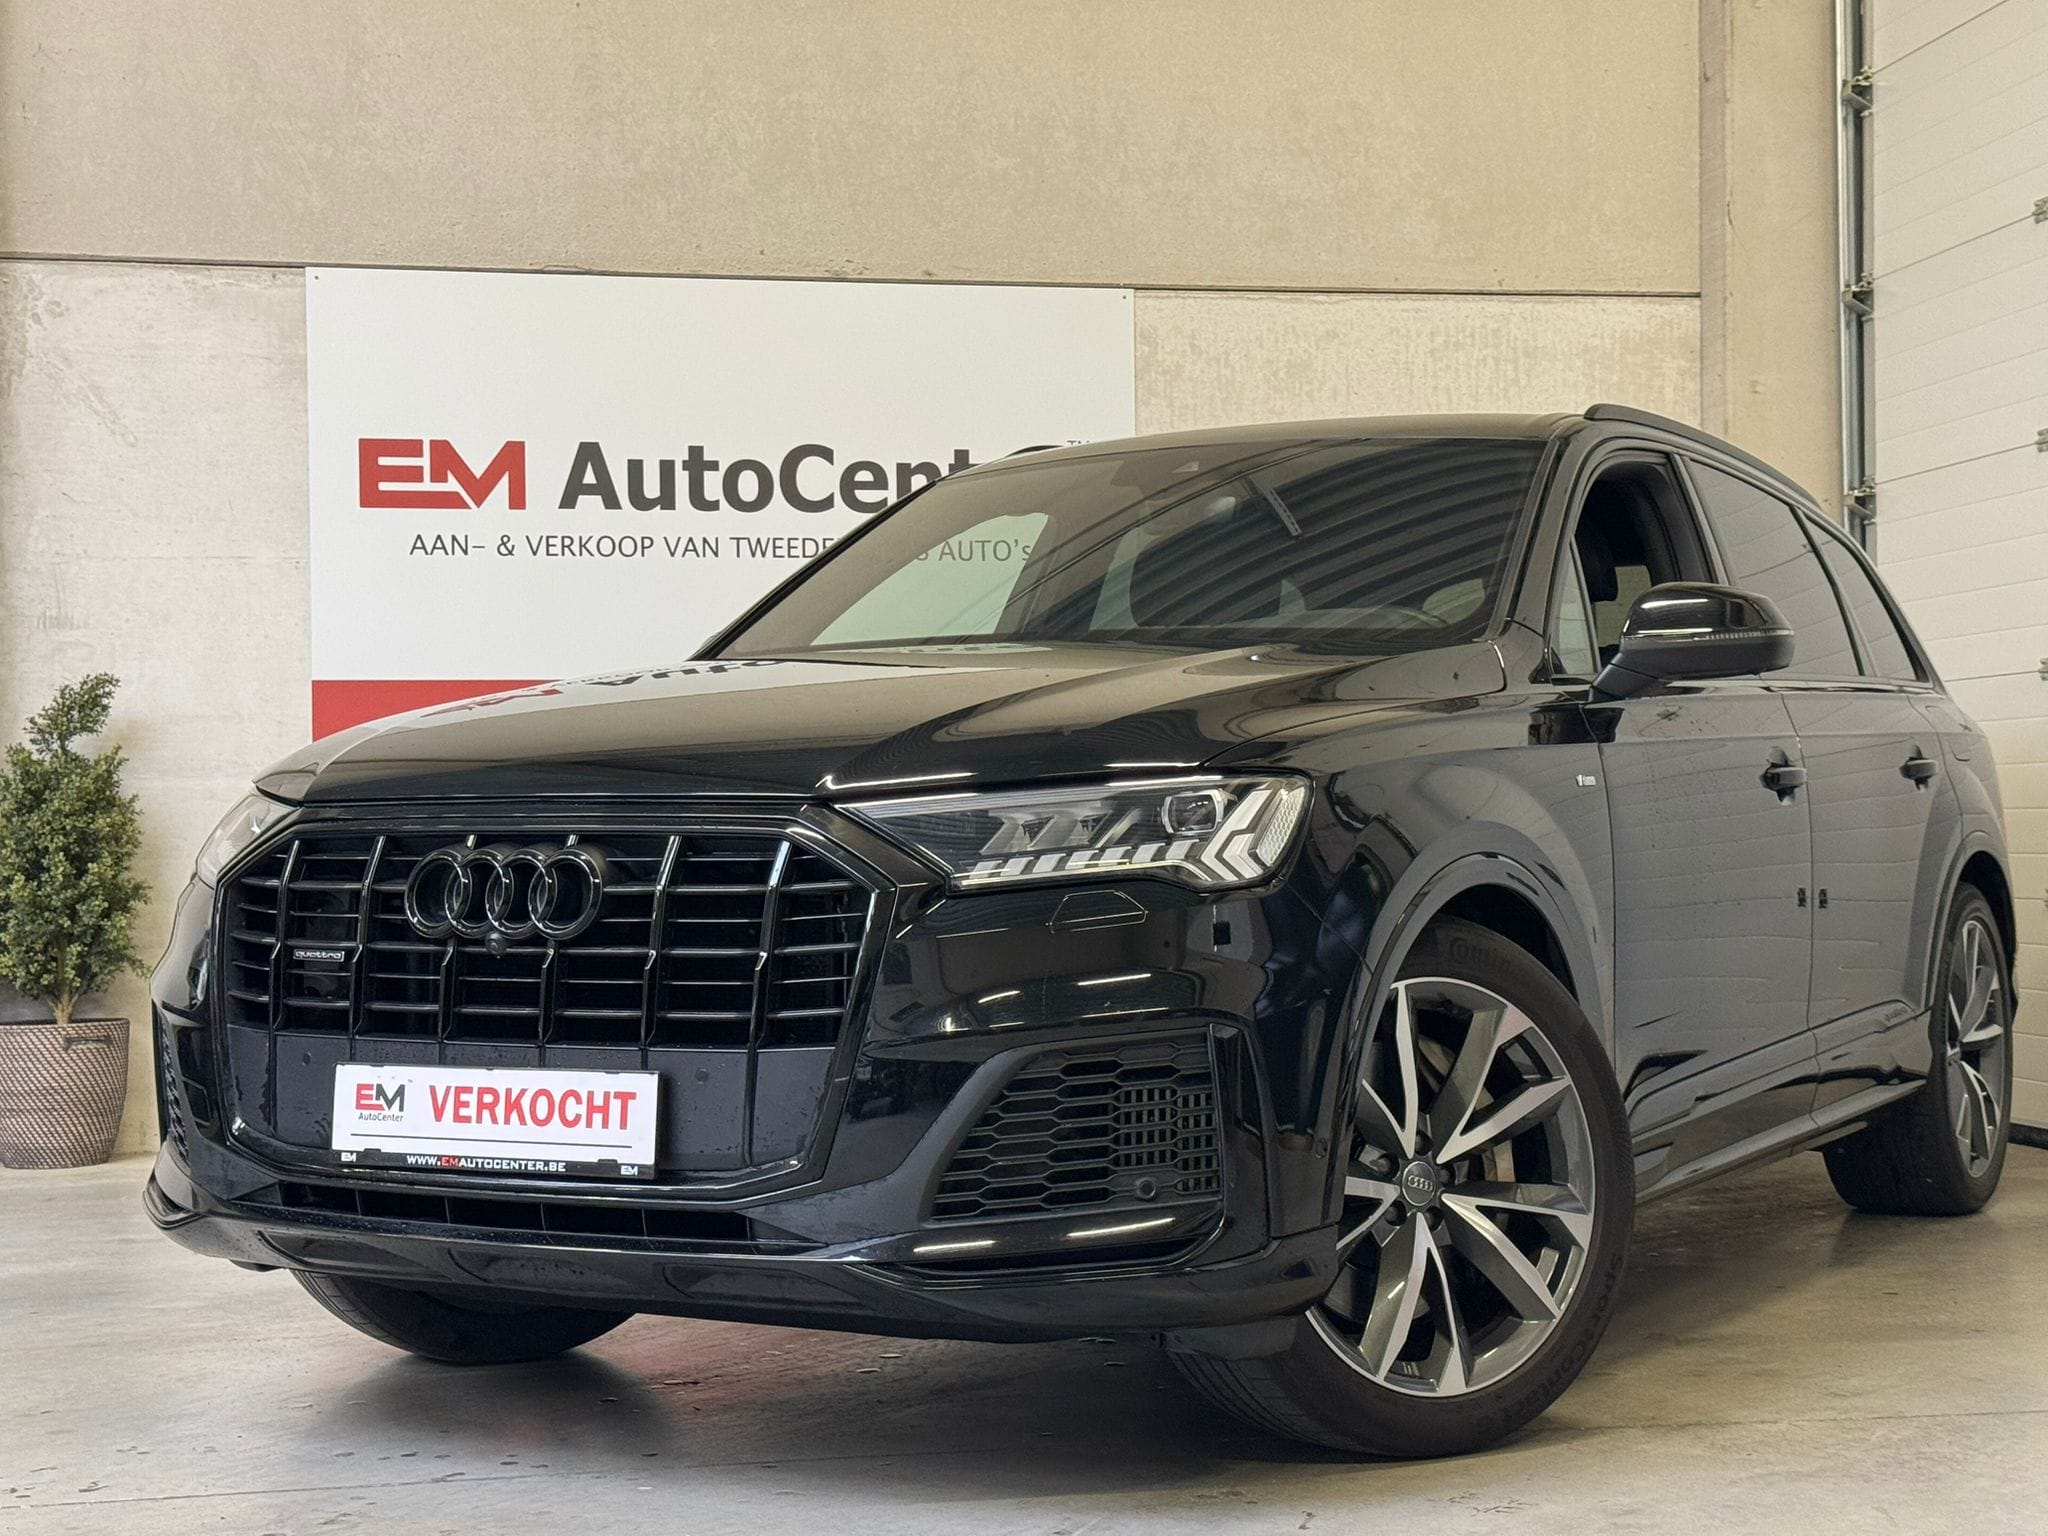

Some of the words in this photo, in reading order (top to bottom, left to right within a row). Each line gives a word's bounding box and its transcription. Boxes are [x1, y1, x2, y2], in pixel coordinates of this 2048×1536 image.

[358, 438, 527, 510] EM
[409, 534, 485, 555] AAN-
[496, 534, 515, 556] &
[525, 535, 654, 558] VERKOOP
[663, 536, 719, 557] VAN
[294, 950, 342, 961] quattro
[355, 1082, 406, 1112] EM
[429, 1084, 637, 1130] VERKOCHT
[358, 1112, 404, 1122] AutoCenter
